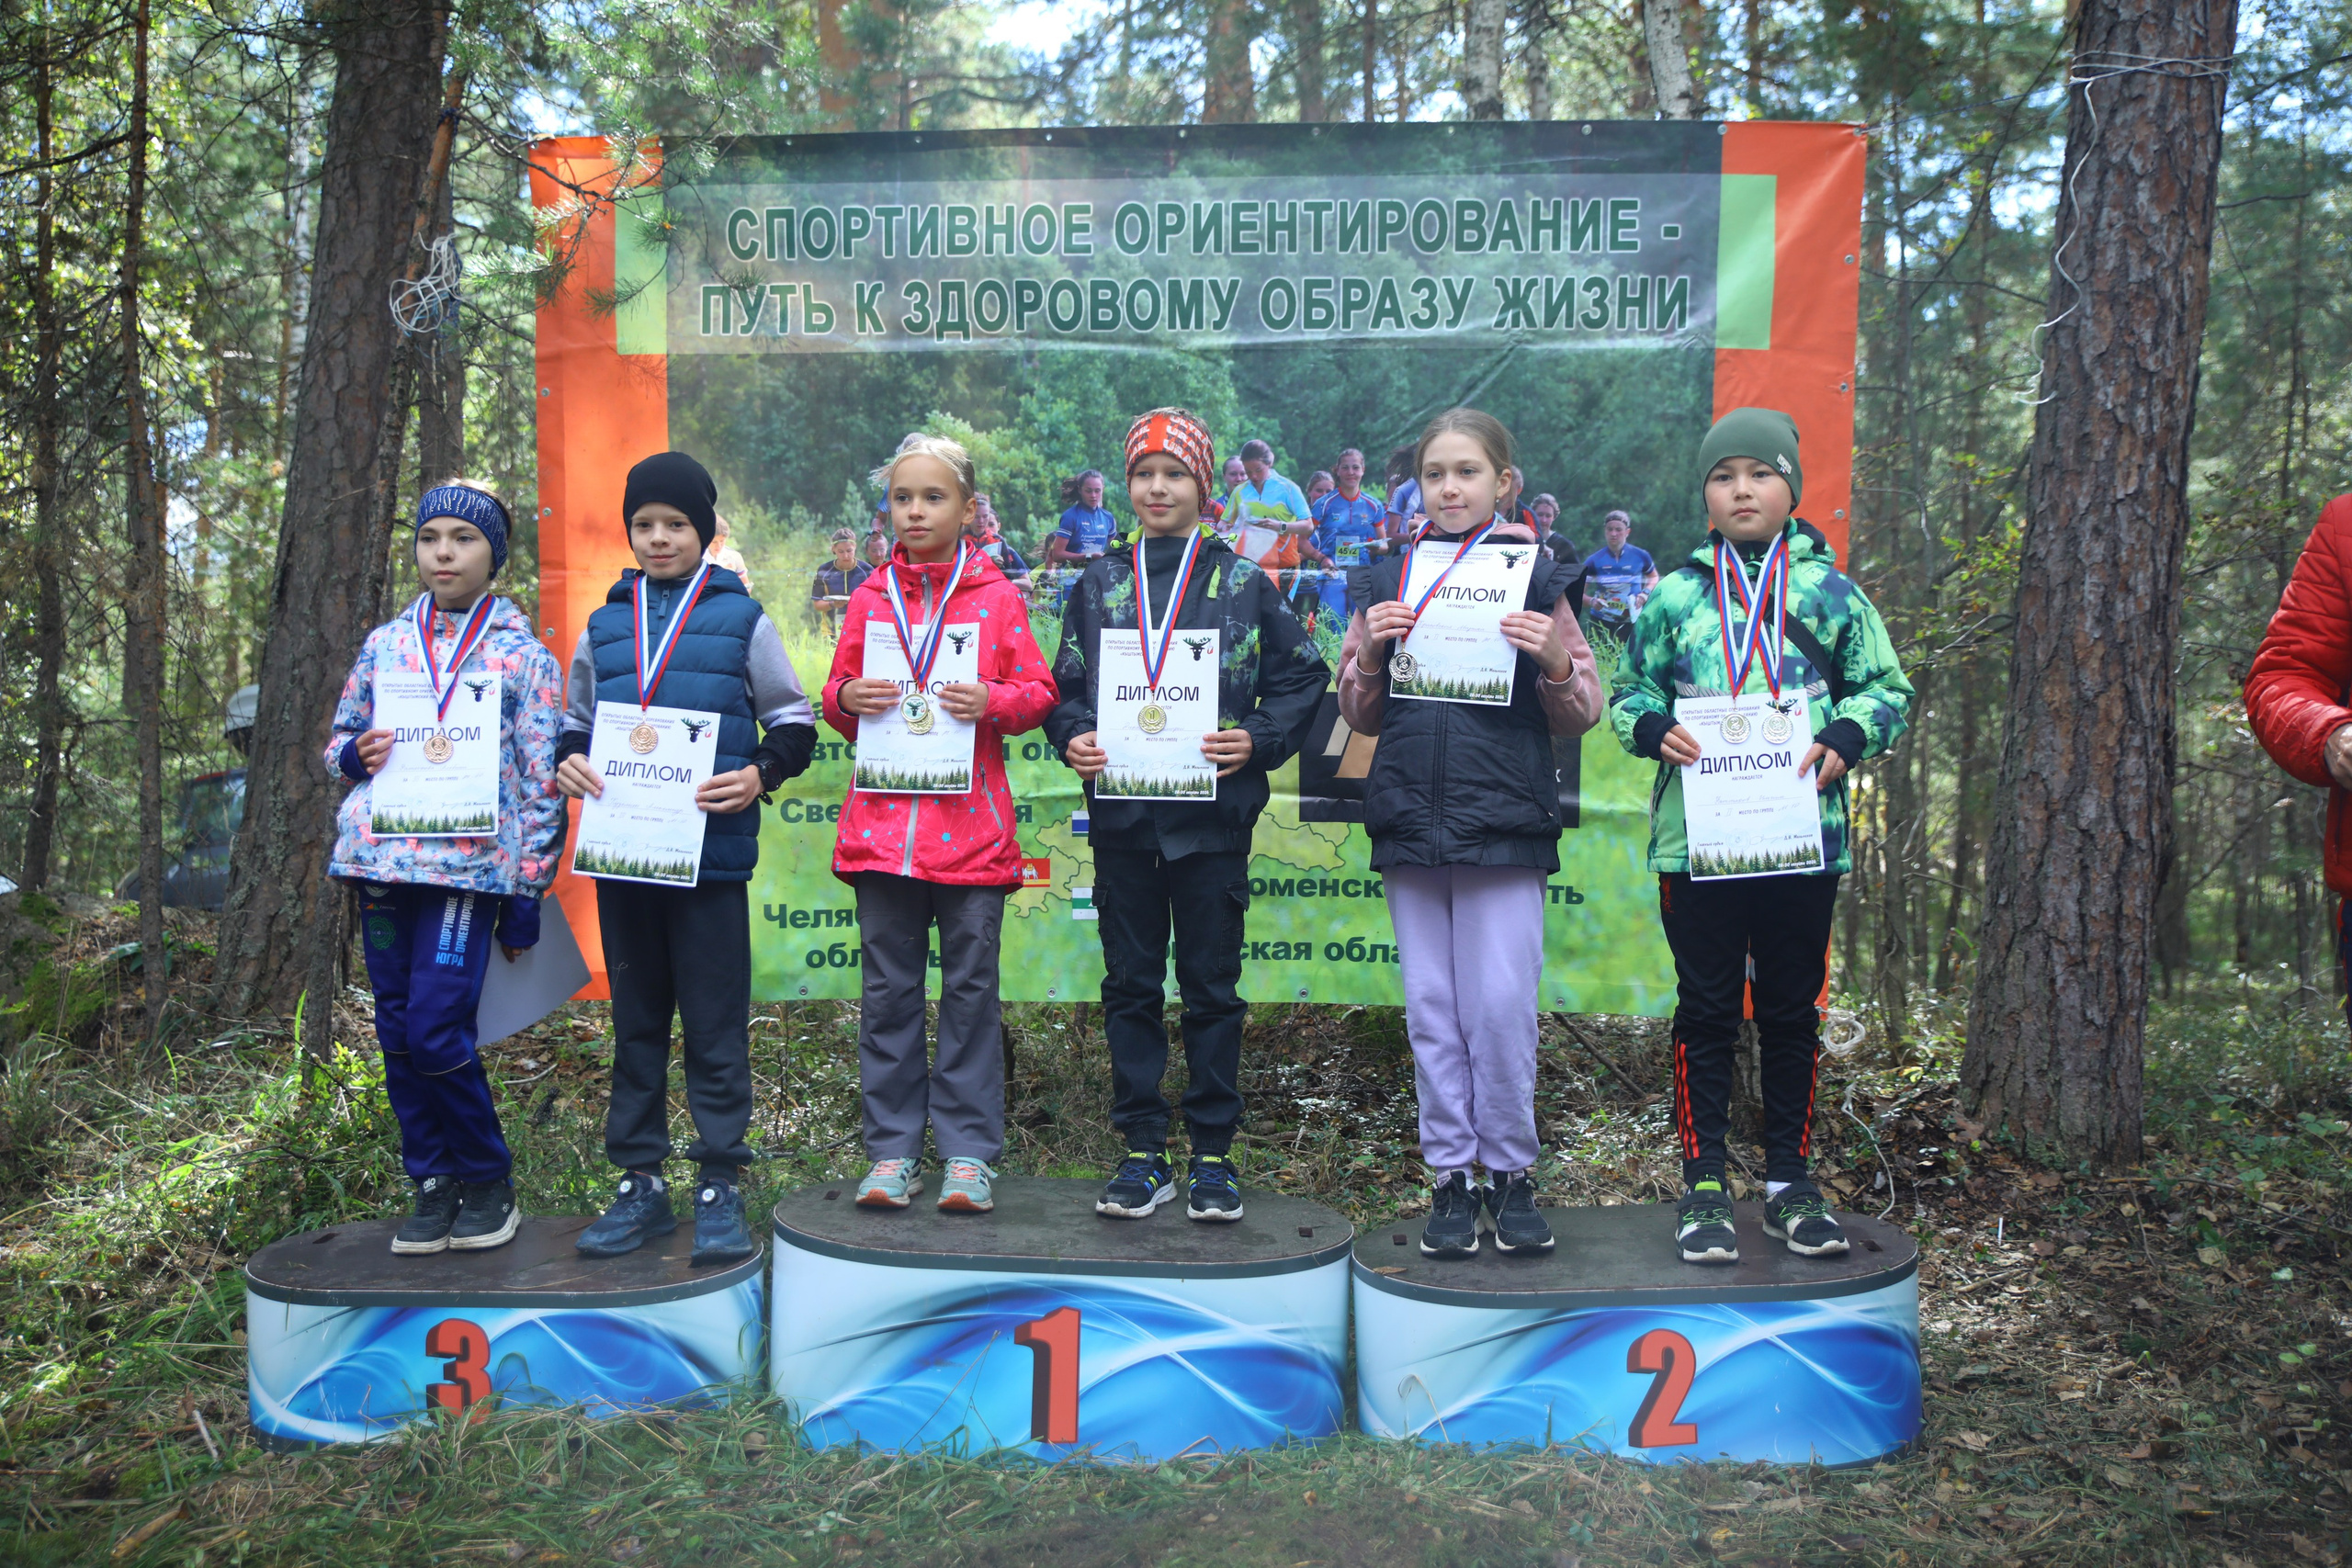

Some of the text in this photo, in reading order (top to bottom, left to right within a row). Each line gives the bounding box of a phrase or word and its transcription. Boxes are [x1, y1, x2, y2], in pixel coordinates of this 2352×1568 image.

[727, 203, 1093, 262] СПОРТИВНОЕ
[1114, 198, 1640, 256] ОРИЕНТИРОВАНИЕ
[700, 275, 1690, 343] ПУТЬ К ЗДОРОВОМУ ОБРАЗУ ЖИЗНИ
[1163, 439, 1197, 475] URAL
[1424, 585, 1506, 603] ИПЛОМ
[1116, 686, 1199, 701] ДИПЛОМ
[394, 727, 480, 743] ДИПЛОМ
[605, 760, 692, 784] ДИПЛОМ
[1700, 751, 1792, 775] ДИПЛОМ
[439, 896, 458, 951] СПОРТИВНОЕ
[455, 891, 476, 953] ОРИЕНТИРОВА
[435, 952, 464, 967] ЮГРА
[423, 1177, 436, 1189] alo
[425, 1317, 492, 1425] 3
[1014, 1305, 1082, 1444] 1
[1627, 1328, 1699, 1448] 2
